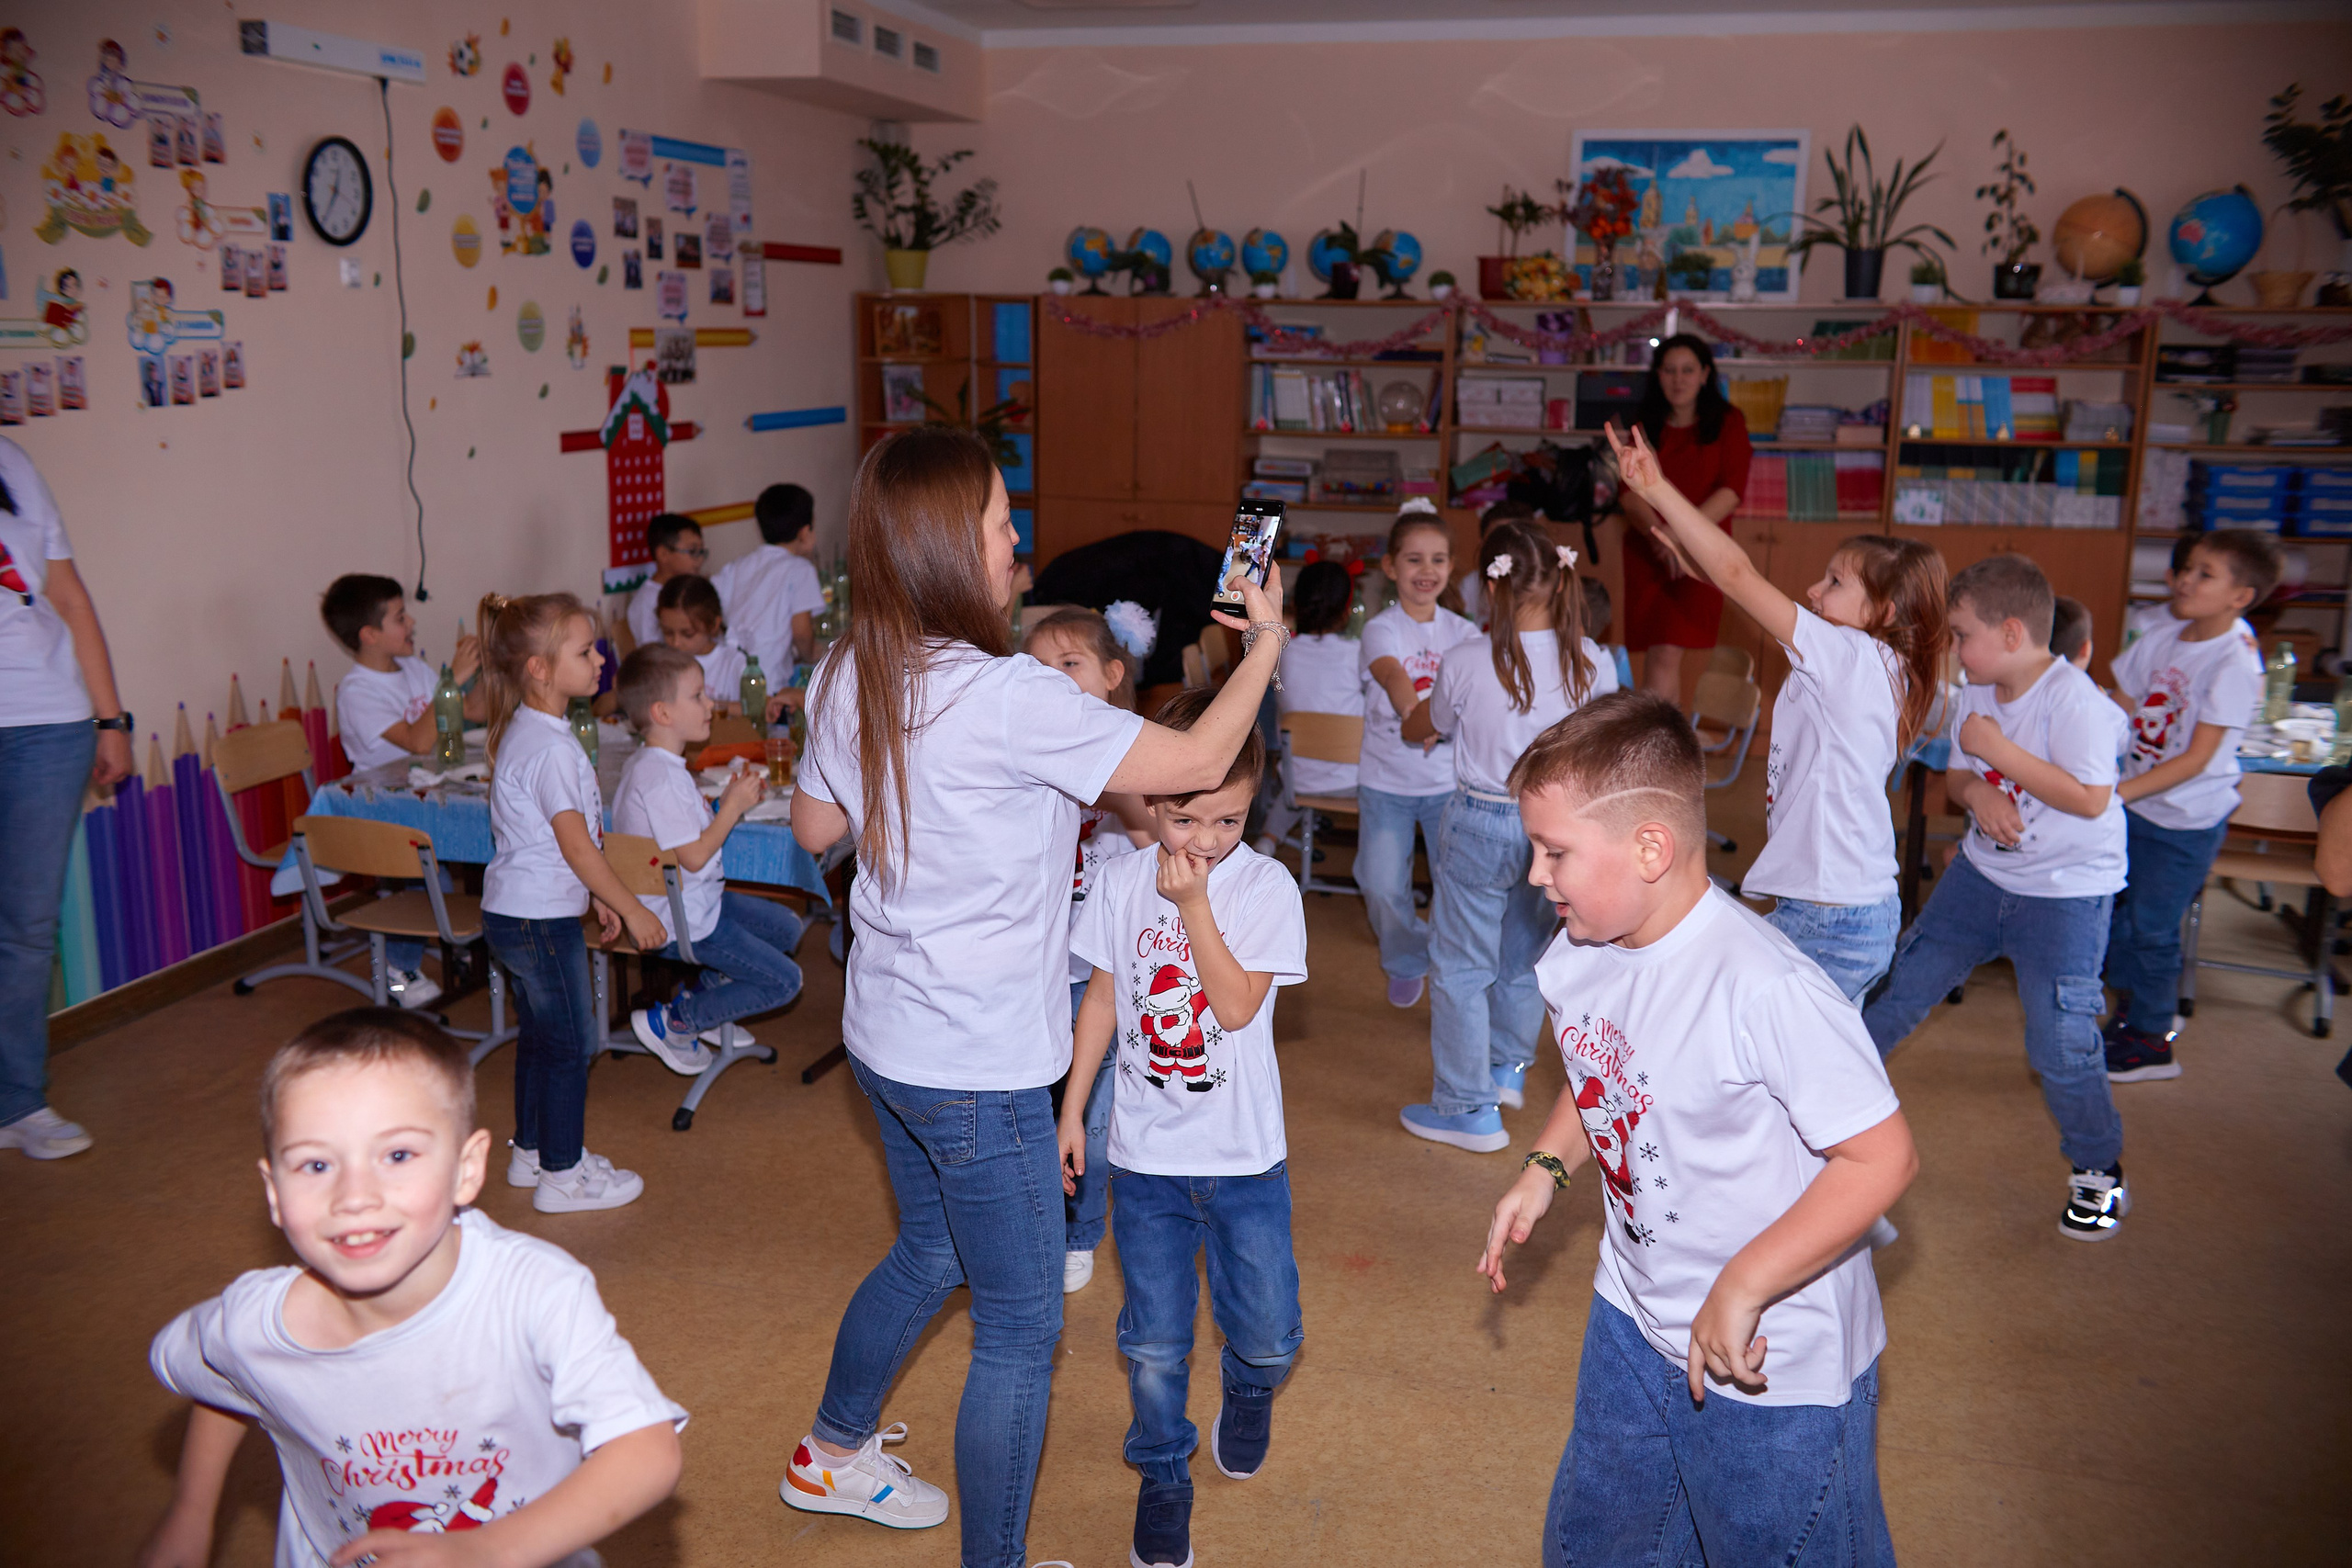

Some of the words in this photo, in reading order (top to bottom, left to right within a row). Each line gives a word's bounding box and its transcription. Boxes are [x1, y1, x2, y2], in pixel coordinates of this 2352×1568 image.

[1136, 928, 1190, 962] Chris
[1595, 1017, 1635, 1064] Merry
[1560, 1026, 1654, 1115] Christmas
[360, 1427, 458, 1459] Merry
[321, 1449, 510, 1496] Christmas
